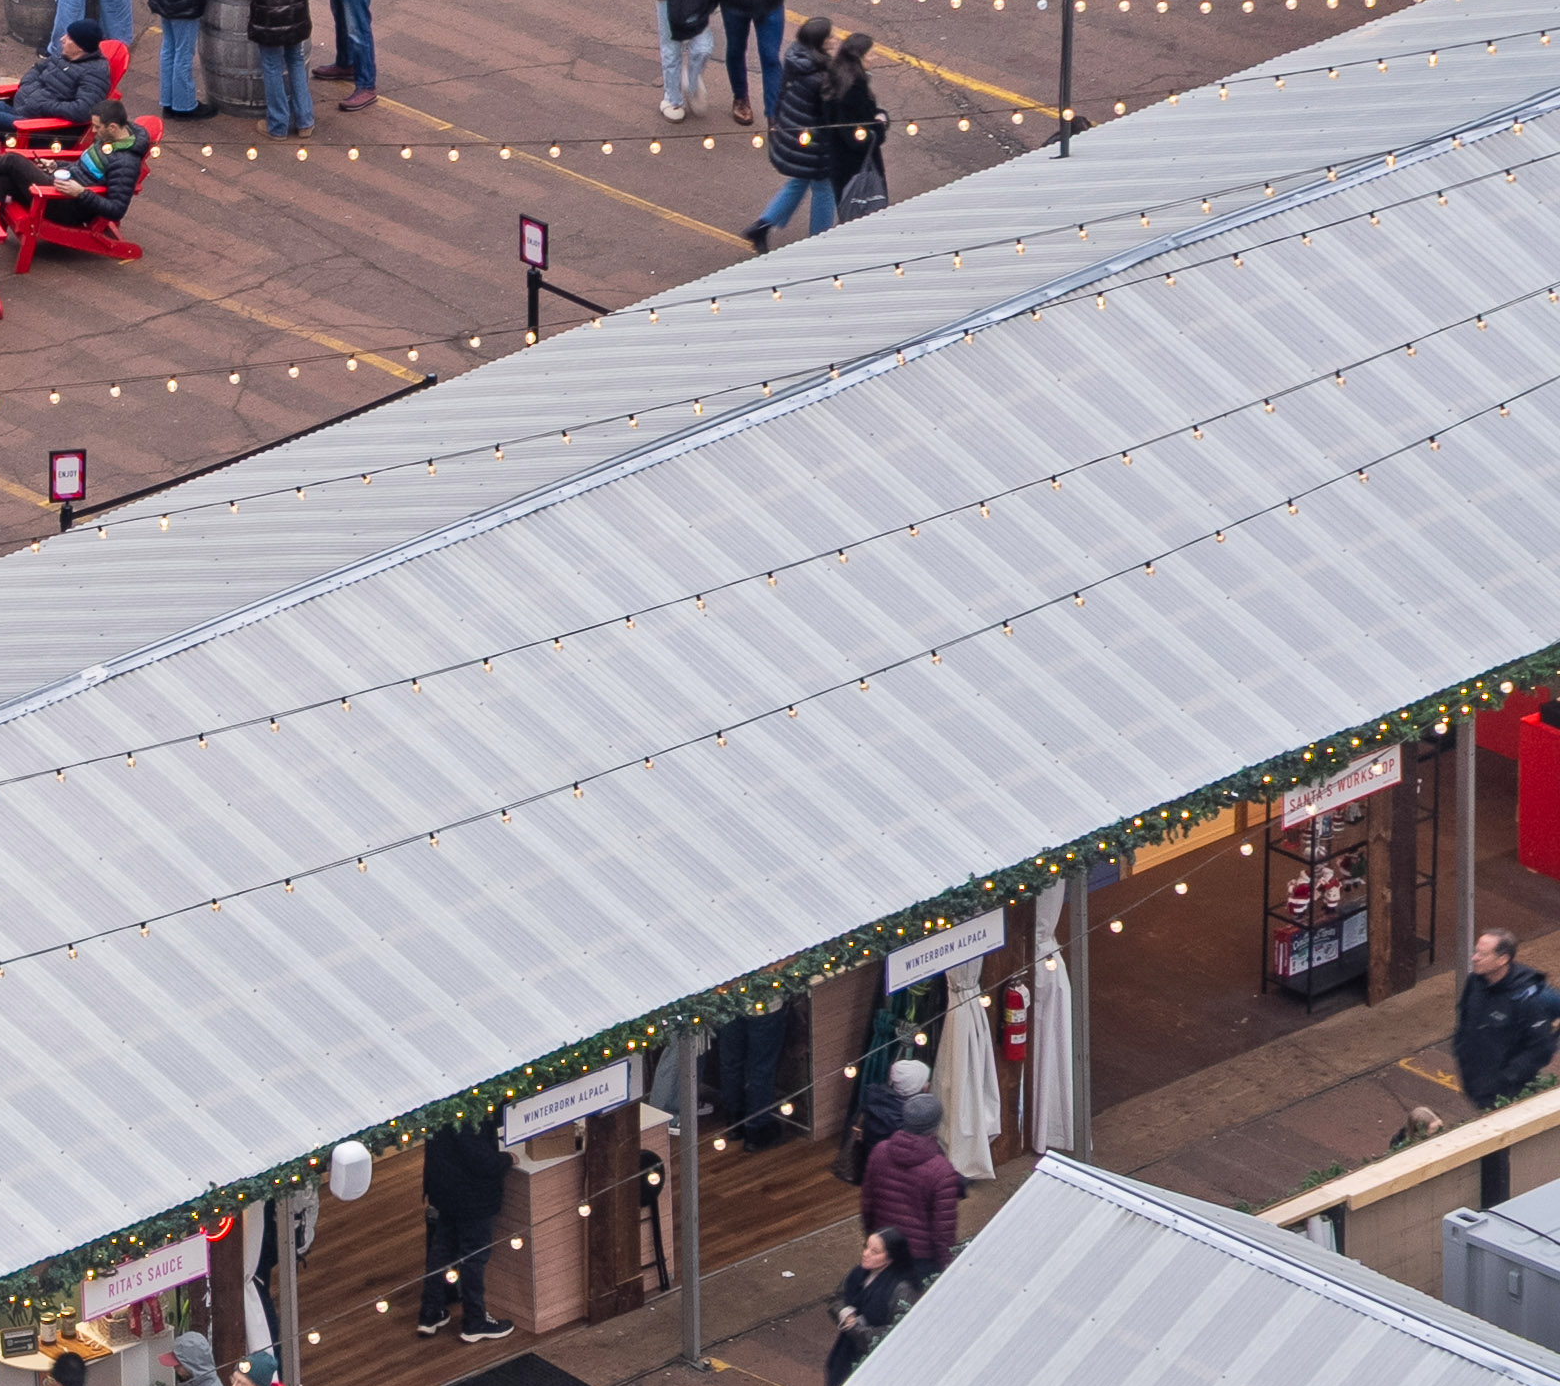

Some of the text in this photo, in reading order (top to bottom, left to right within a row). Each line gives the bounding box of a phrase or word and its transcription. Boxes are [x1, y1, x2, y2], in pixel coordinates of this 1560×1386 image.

[905, 928, 988, 972] WINTERBORN ALPACA
[522, 1082, 610, 1124] WINTERBORN ALPACA
[107, 1255, 184, 1298] RITA'S SAUCE
